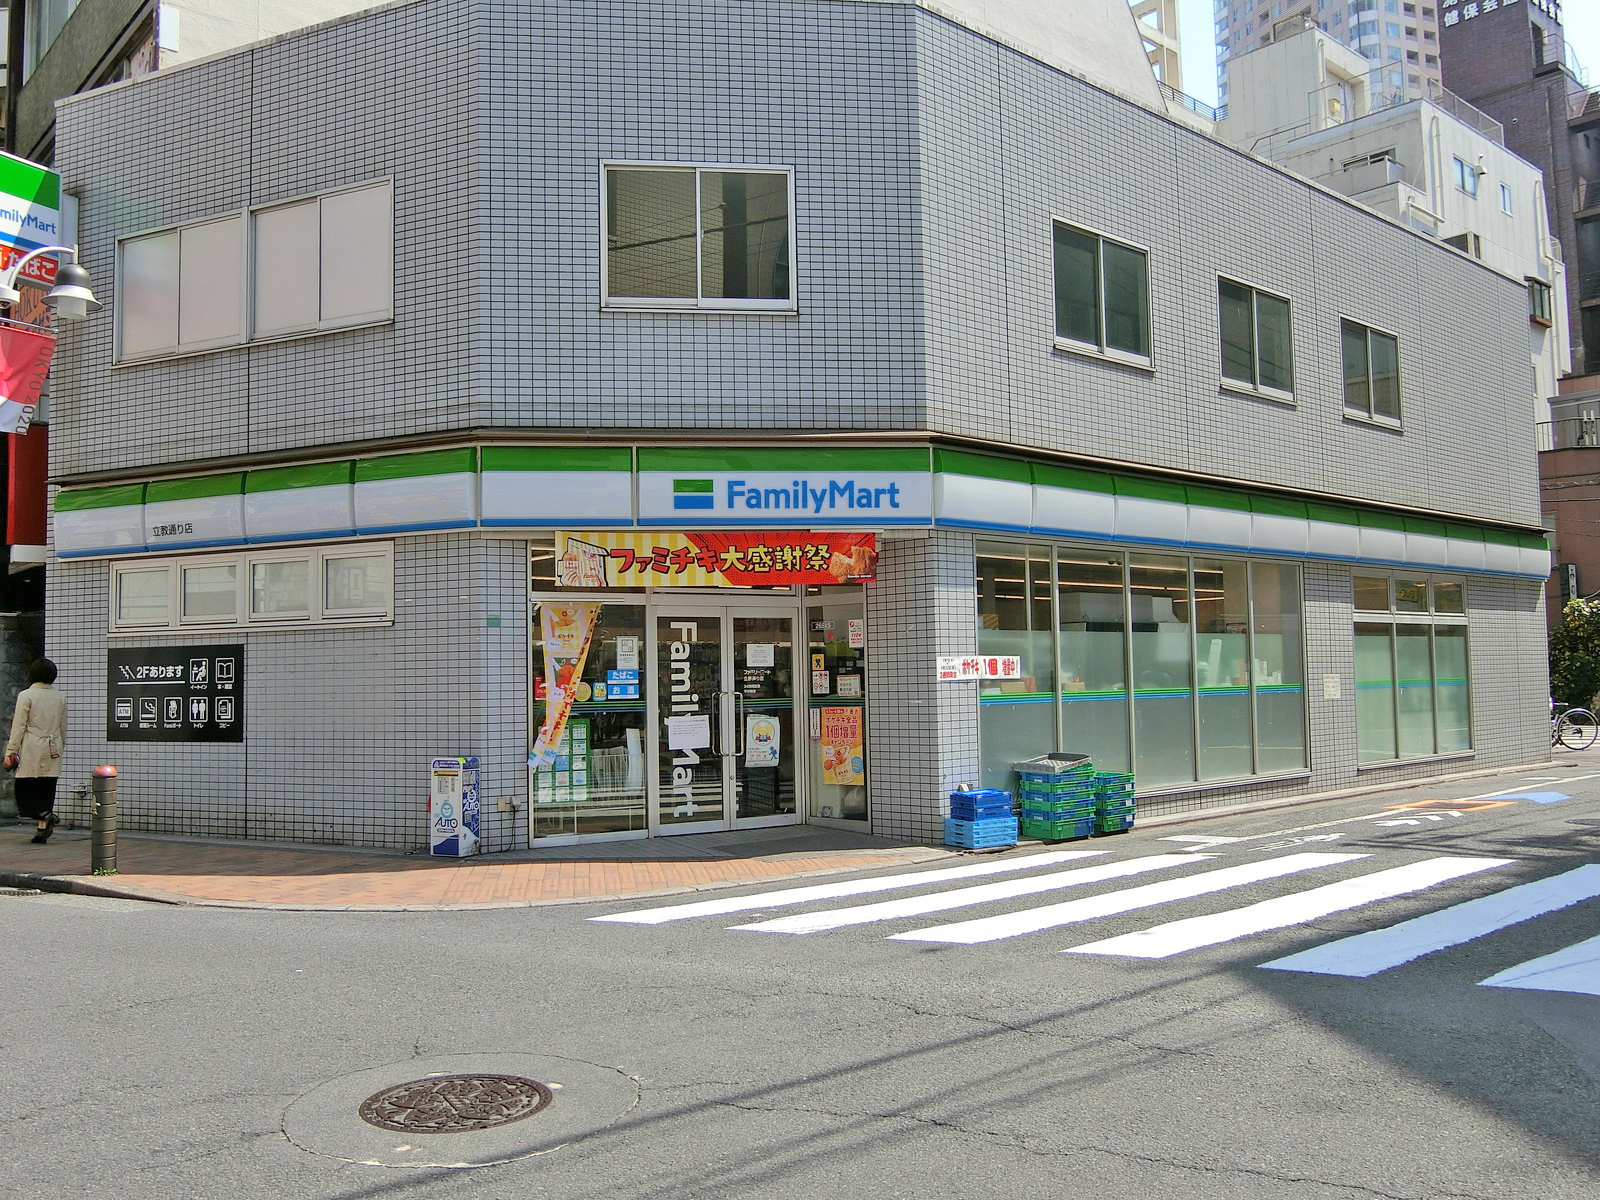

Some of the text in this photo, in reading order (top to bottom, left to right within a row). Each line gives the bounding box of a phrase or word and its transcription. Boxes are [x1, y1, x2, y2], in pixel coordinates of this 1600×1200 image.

[727, 480, 900, 513] FamilyMart
[152, 522, 193, 537] 立教通り店
[610, 543, 831, 575] ファミチキ大感謝祭
[136, 664, 184, 679] 2Fあります
[612, 671, 634, 680] たばこ
[825, 724, 858, 739] 1個増量
[434, 817, 458, 828] AUTO
